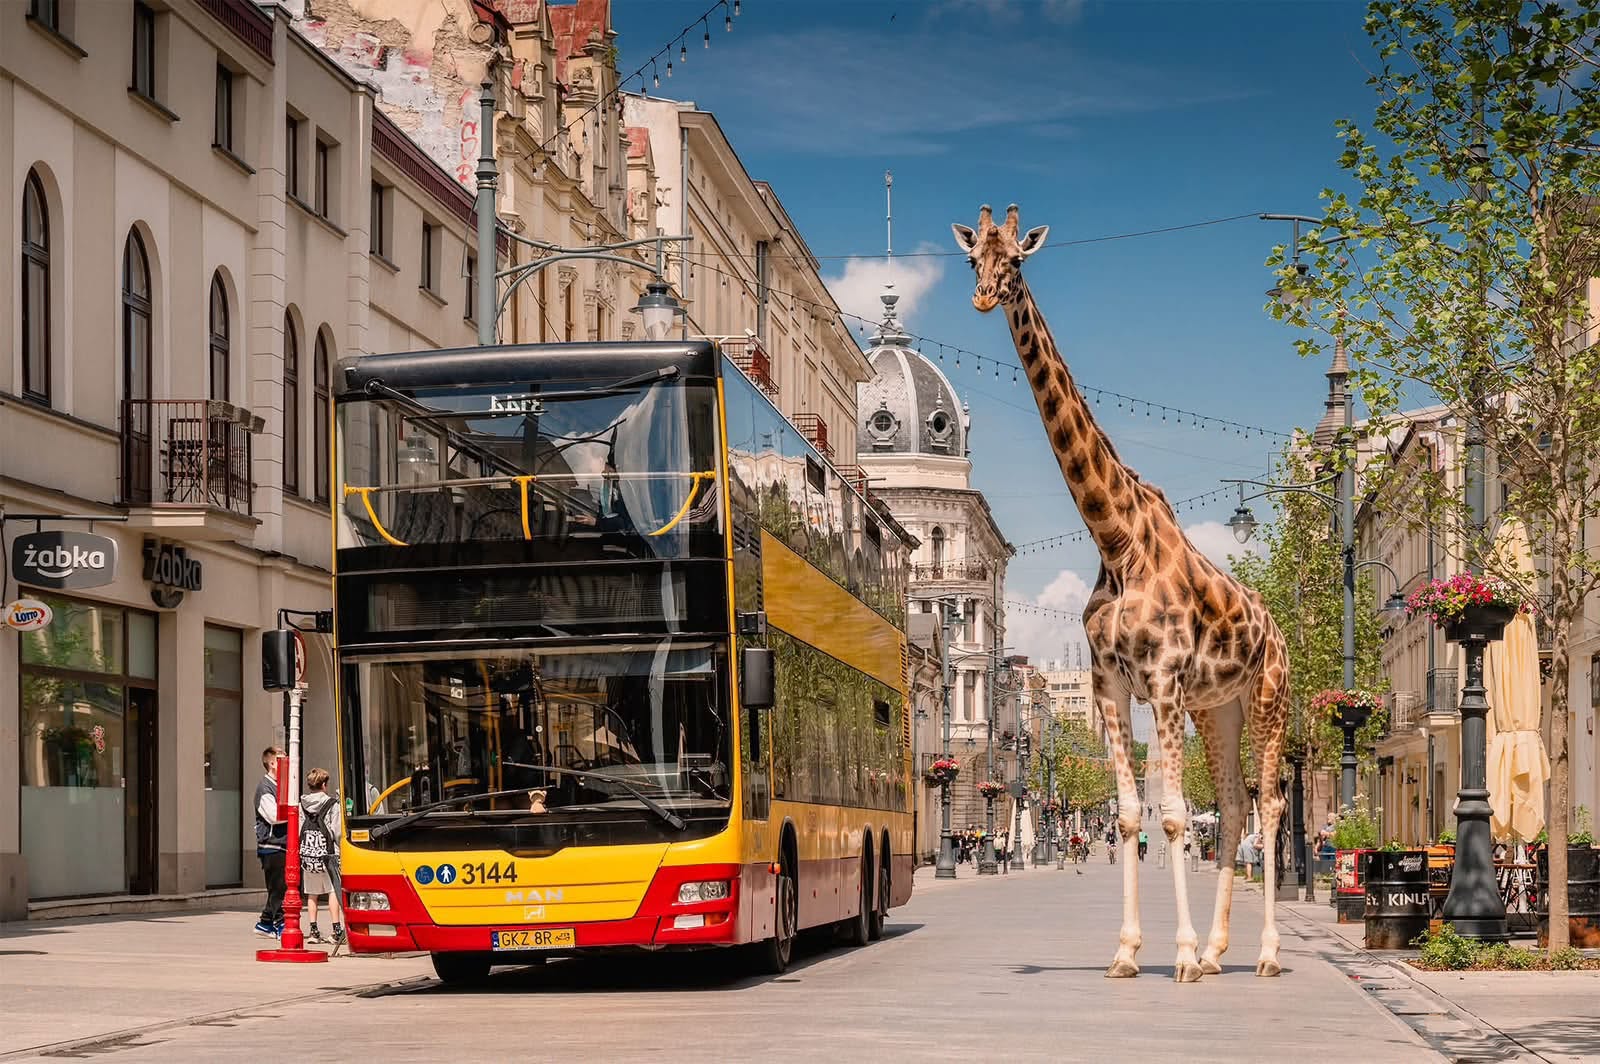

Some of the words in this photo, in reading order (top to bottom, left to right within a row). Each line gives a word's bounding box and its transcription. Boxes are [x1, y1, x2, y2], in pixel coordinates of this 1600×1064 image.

[23, 543, 105, 569] żabka
[15, 610, 38, 622] LOTTO
[461, 862, 518, 885] 3144
[505, 889, 564, 902] MAN
[501, 931, 530, 947] GKZ
[534, 931, 553, 945] 8R
